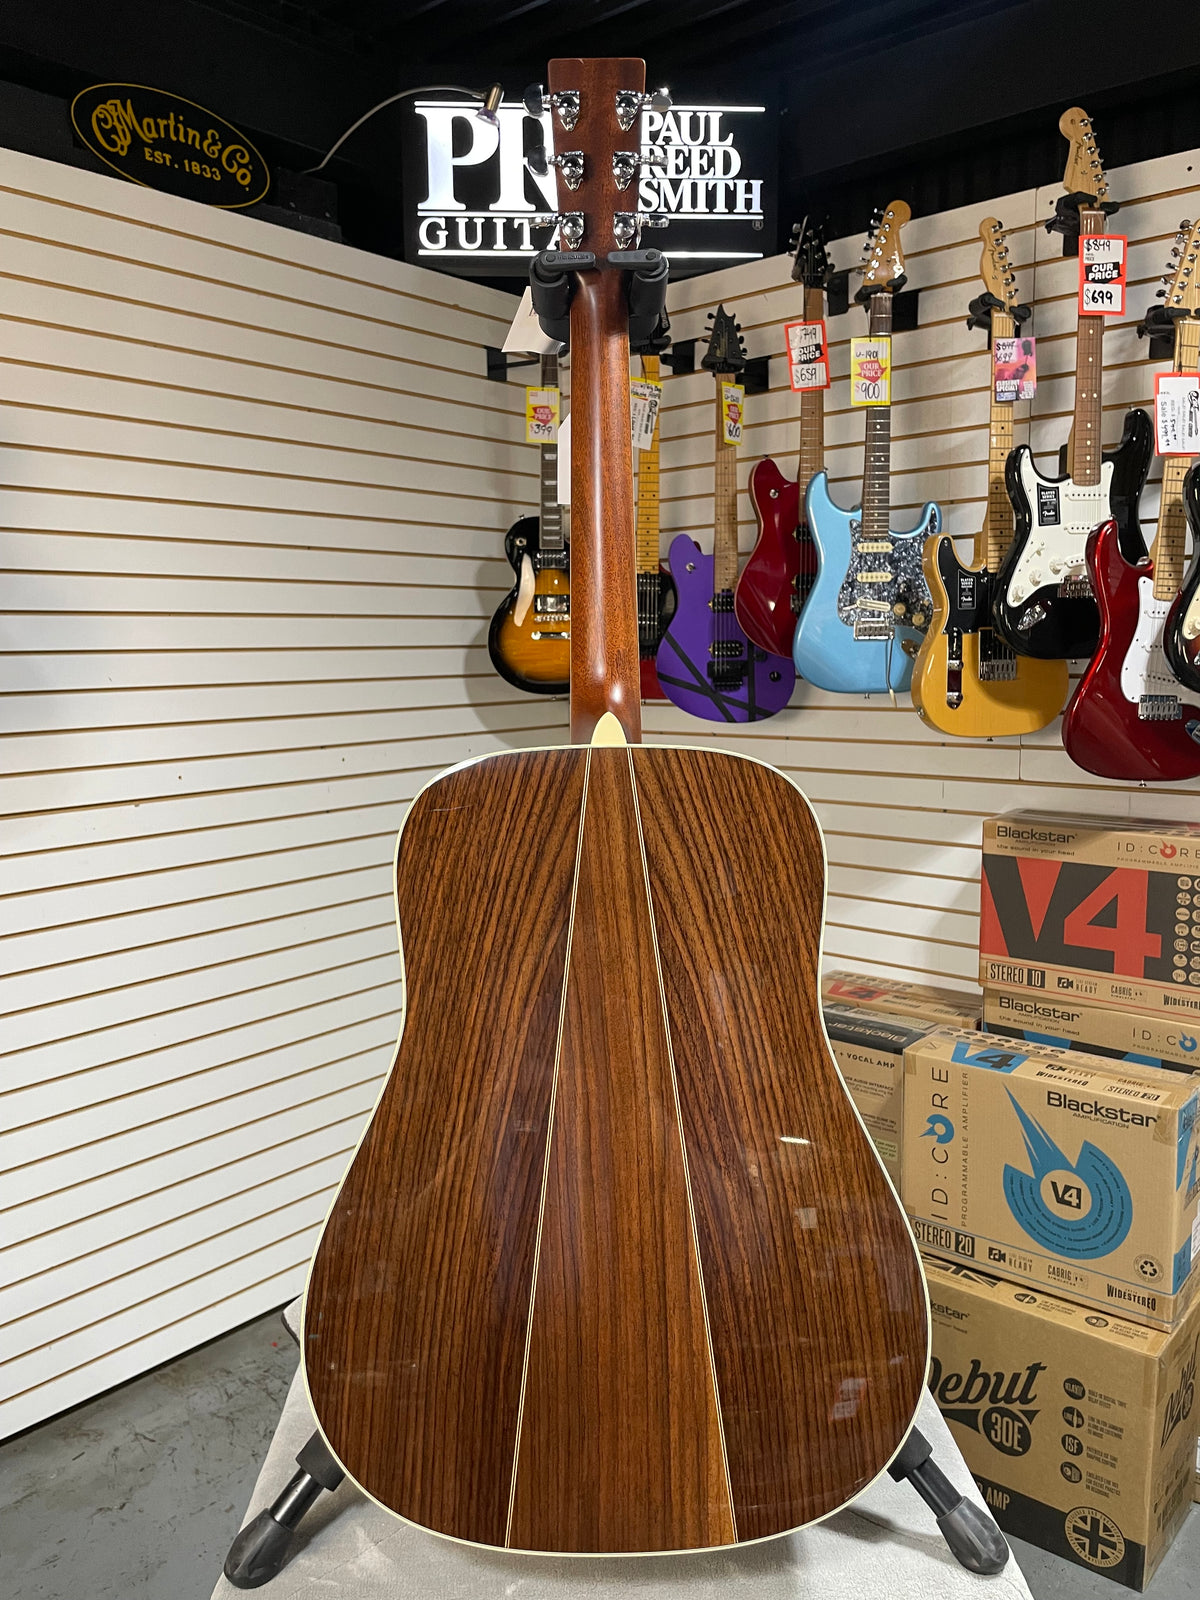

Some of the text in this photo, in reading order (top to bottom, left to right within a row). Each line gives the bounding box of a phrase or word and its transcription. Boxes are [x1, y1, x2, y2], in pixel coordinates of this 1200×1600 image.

[640, 111, 734, 147] PAUL
[143, 147, 222, 181] EST. 1833
[415, 107, 559, 212] PR
[640, 145, 742, 180] REED
[637, 179, 764, 213] SMITH
[1084, 238, 1111, 252] $849
[1088, 270, 1119, 281] PRICE
[1091, 263, 1113, 273] OUR
[1085, 288, 1113, 306] $699
[860, 368, 882, 377] PRICE
[855, 382, 880, 400] $900
[997, 825, 1076, 844] Blackstar
[990, 962, 1025, 985] STEREO
[1031, 969, 1041, 987] 10
[999, 996, 1080, 1022] Blackstar
[847, 1052, 875, 1066] VOCAL
[876, 1061, 896, 1070] AMP
[1107, 1085, 1141, 1098] STEREO
[1047, 1090, 1158, 1129] Blackstar
[1072, 1112, 1130, 1130] AMPLIFICATION
[961, 1071, 970, 1227] PROGRAMMABLE AMPLIFIER
[1050, 1181, 1082, 1210] V4
[914, 1222, 974, 1257] STEREO 20
[1107, 1283, 1156, 1312] WIDESTEREO
[989, 1412, 1024, 1453] 30E
[1065, 1435, 1080, 1454] ISF
[986, 1487, 1010, 1511] AMP
